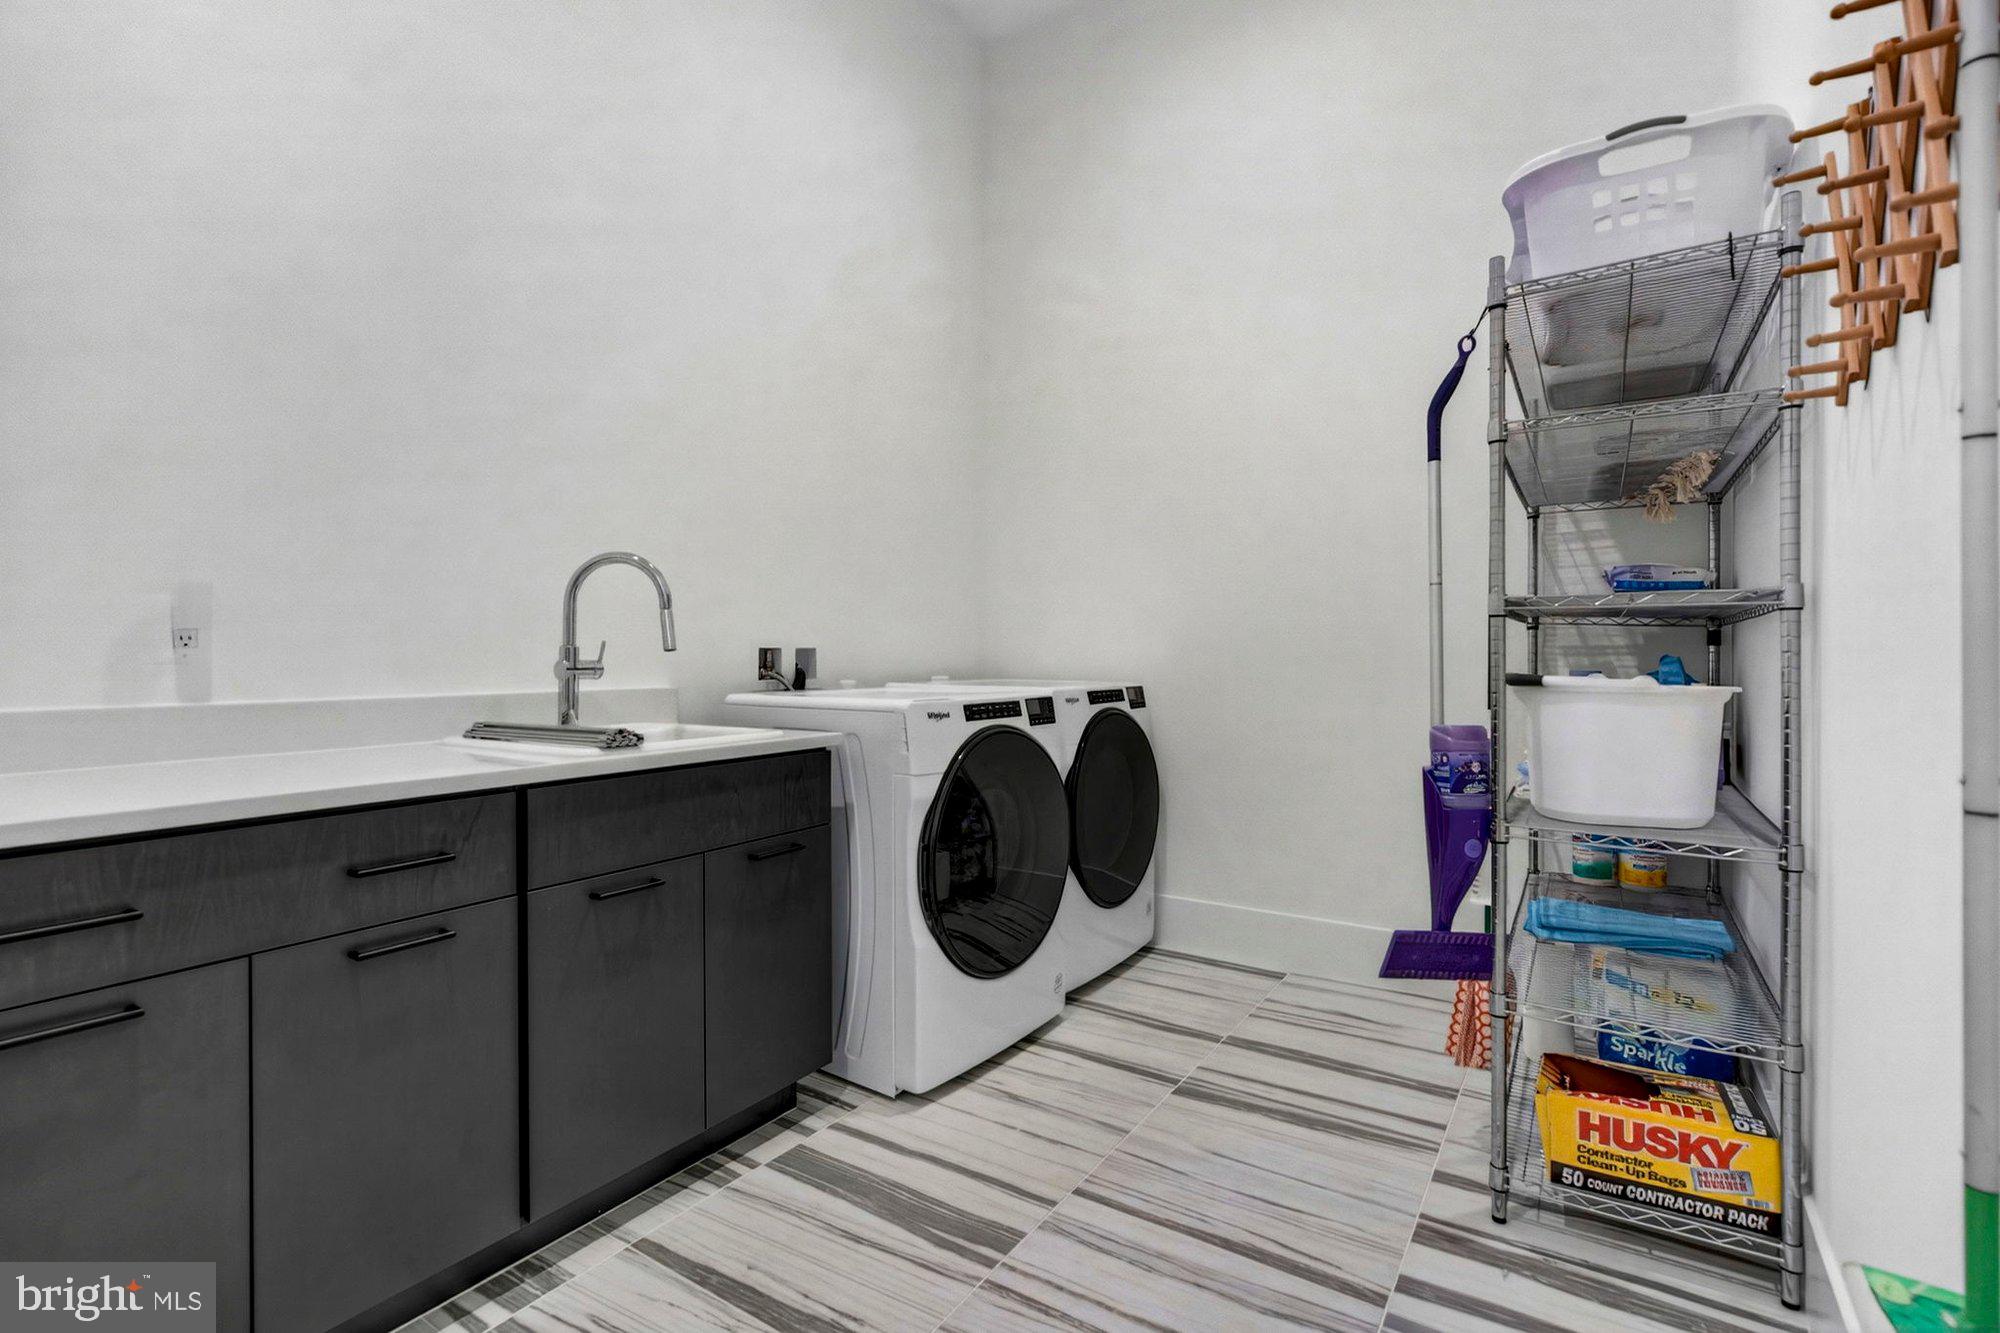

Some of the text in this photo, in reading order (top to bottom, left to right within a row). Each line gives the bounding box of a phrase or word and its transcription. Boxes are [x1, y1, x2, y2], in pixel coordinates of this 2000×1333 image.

[1610, 1036, 1687, 1074] Sparkle
[1577, 1144, 1654, 1169] Contractor
[1578, 1110, 1744, 1170] HUSKY
[1577, 1154, 1645, 1179] Clean-Up
[1648, 1171, 1687, 1189] Bags
[1561, 1167, 1584, 1187] 50
[1587, 1178, 1624, 1195] COUNT
[1626, 1185, 1725, 1220] CONTRACTOR
[1727, 1209, 1769, 1231] PACK
